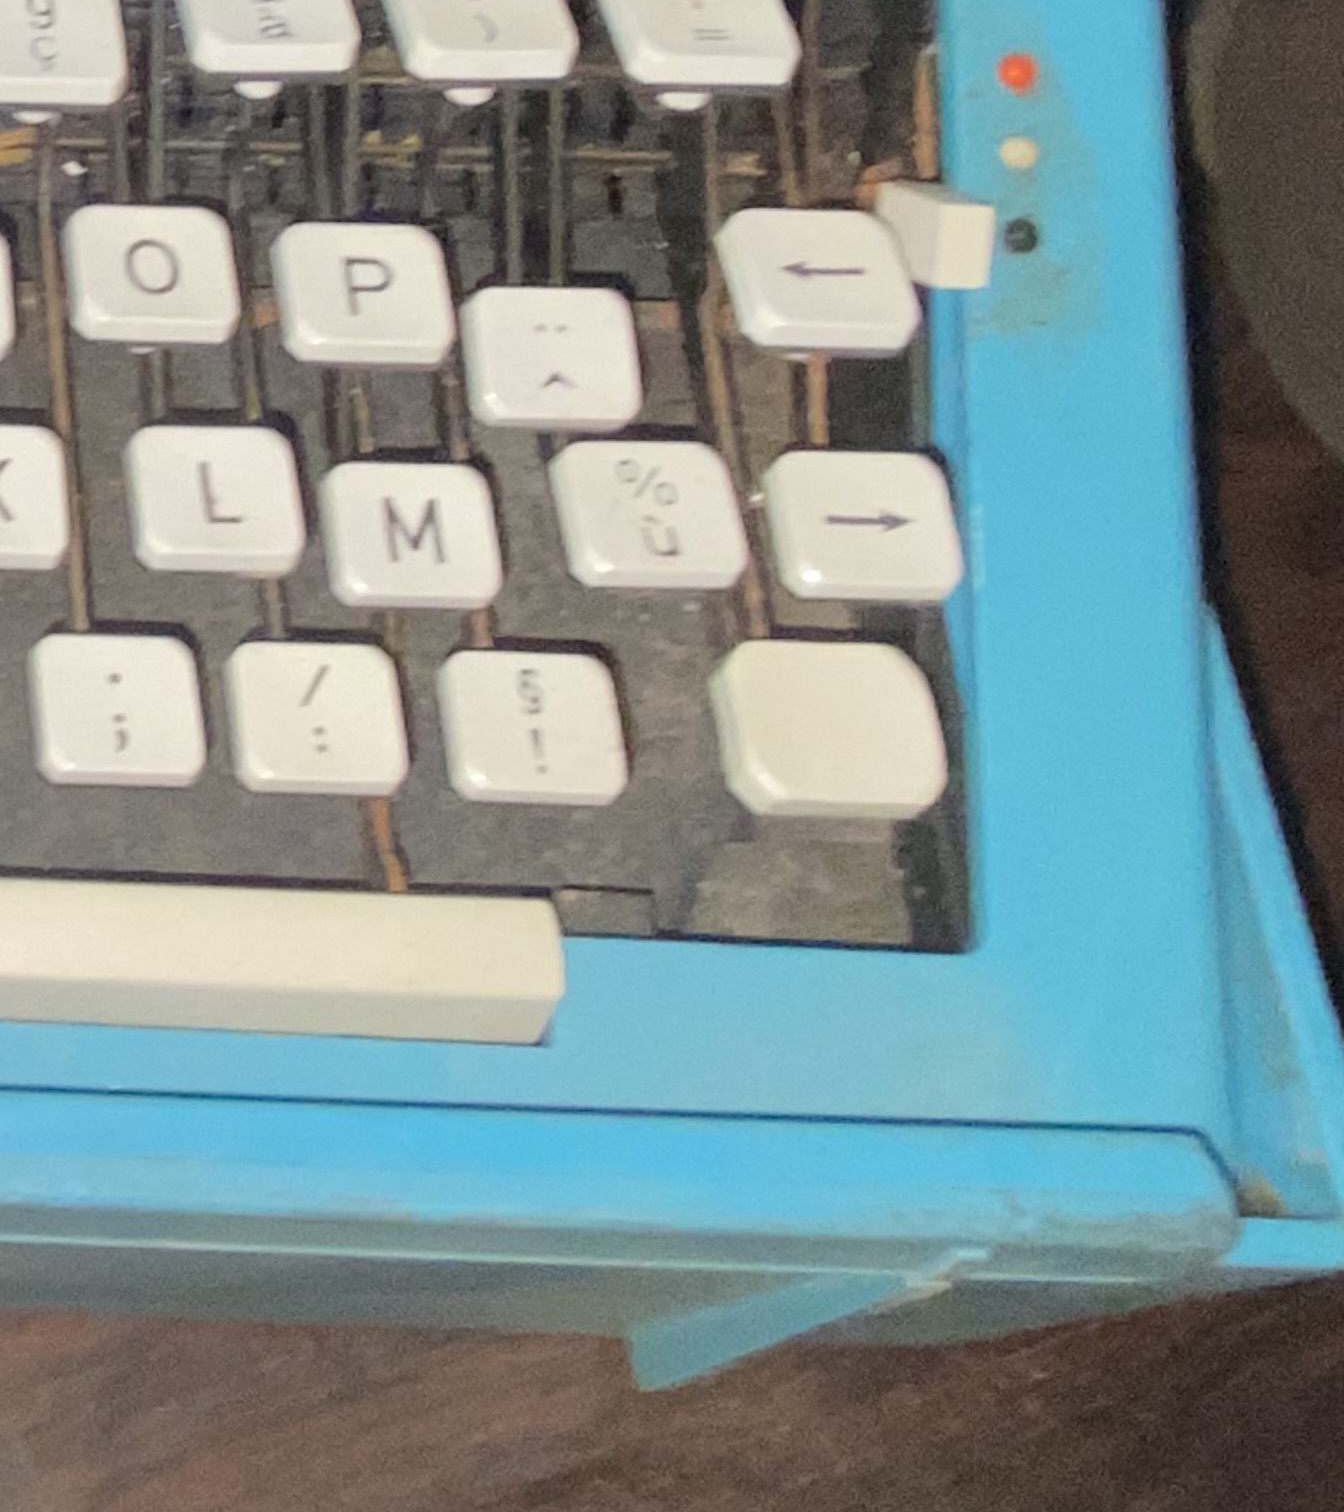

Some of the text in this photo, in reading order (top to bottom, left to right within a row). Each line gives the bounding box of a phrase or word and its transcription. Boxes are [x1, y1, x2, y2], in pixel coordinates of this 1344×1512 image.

[692, 28, 734, 42] =
[124, 238, 180, 296] O
[343, 256, 393, 315] P
[197, 461, 244, 525] L
[613, 458, 680, 507] %
[383, 497, 445, 563] M
[300, 664, 330, 707] /
[112, 713, 130, 752] ;
[311, 725, 329, 754] :
[528, 728, 548, 774] !
